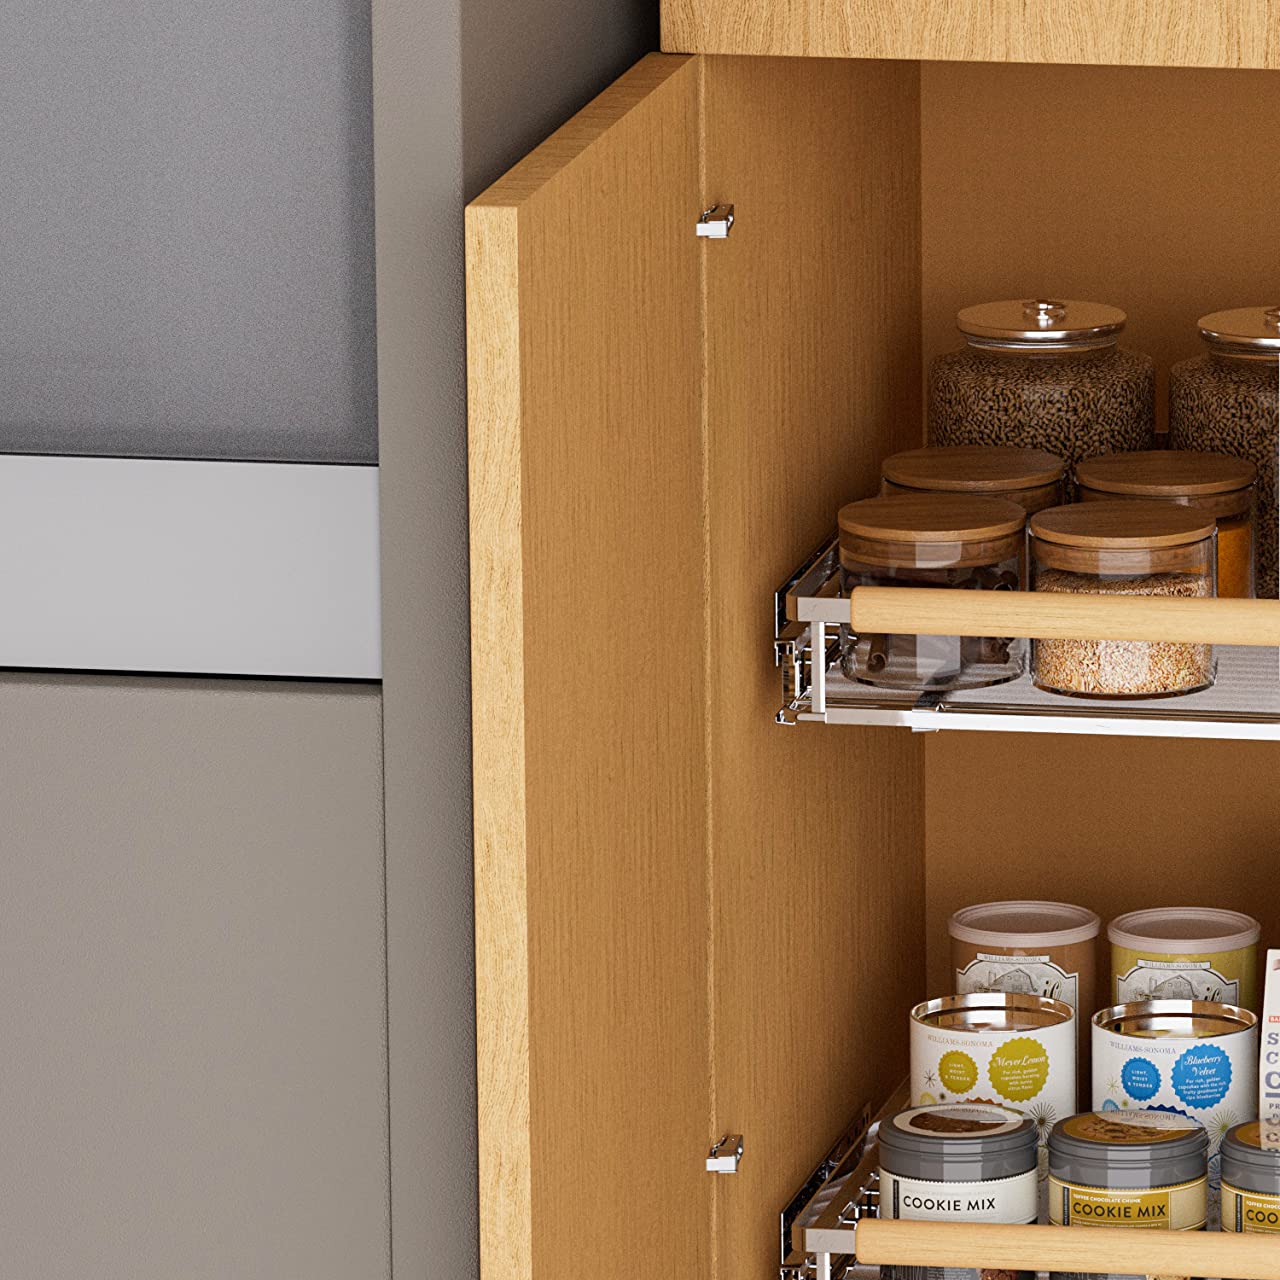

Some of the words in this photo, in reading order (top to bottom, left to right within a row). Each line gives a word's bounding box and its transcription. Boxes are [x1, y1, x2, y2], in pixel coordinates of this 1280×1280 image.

[1184, 1055, 1222, 1066] Blueberry
[1192, 1066, 1217, 1076] Velvet
[903, 1195, 961, 1211] COOKIE
[967, 1198, 995, 1211] MIX
[1073, 1202, 1132, 1218] COOKIE
[1137, 1204, 1166, 1217] MIX
